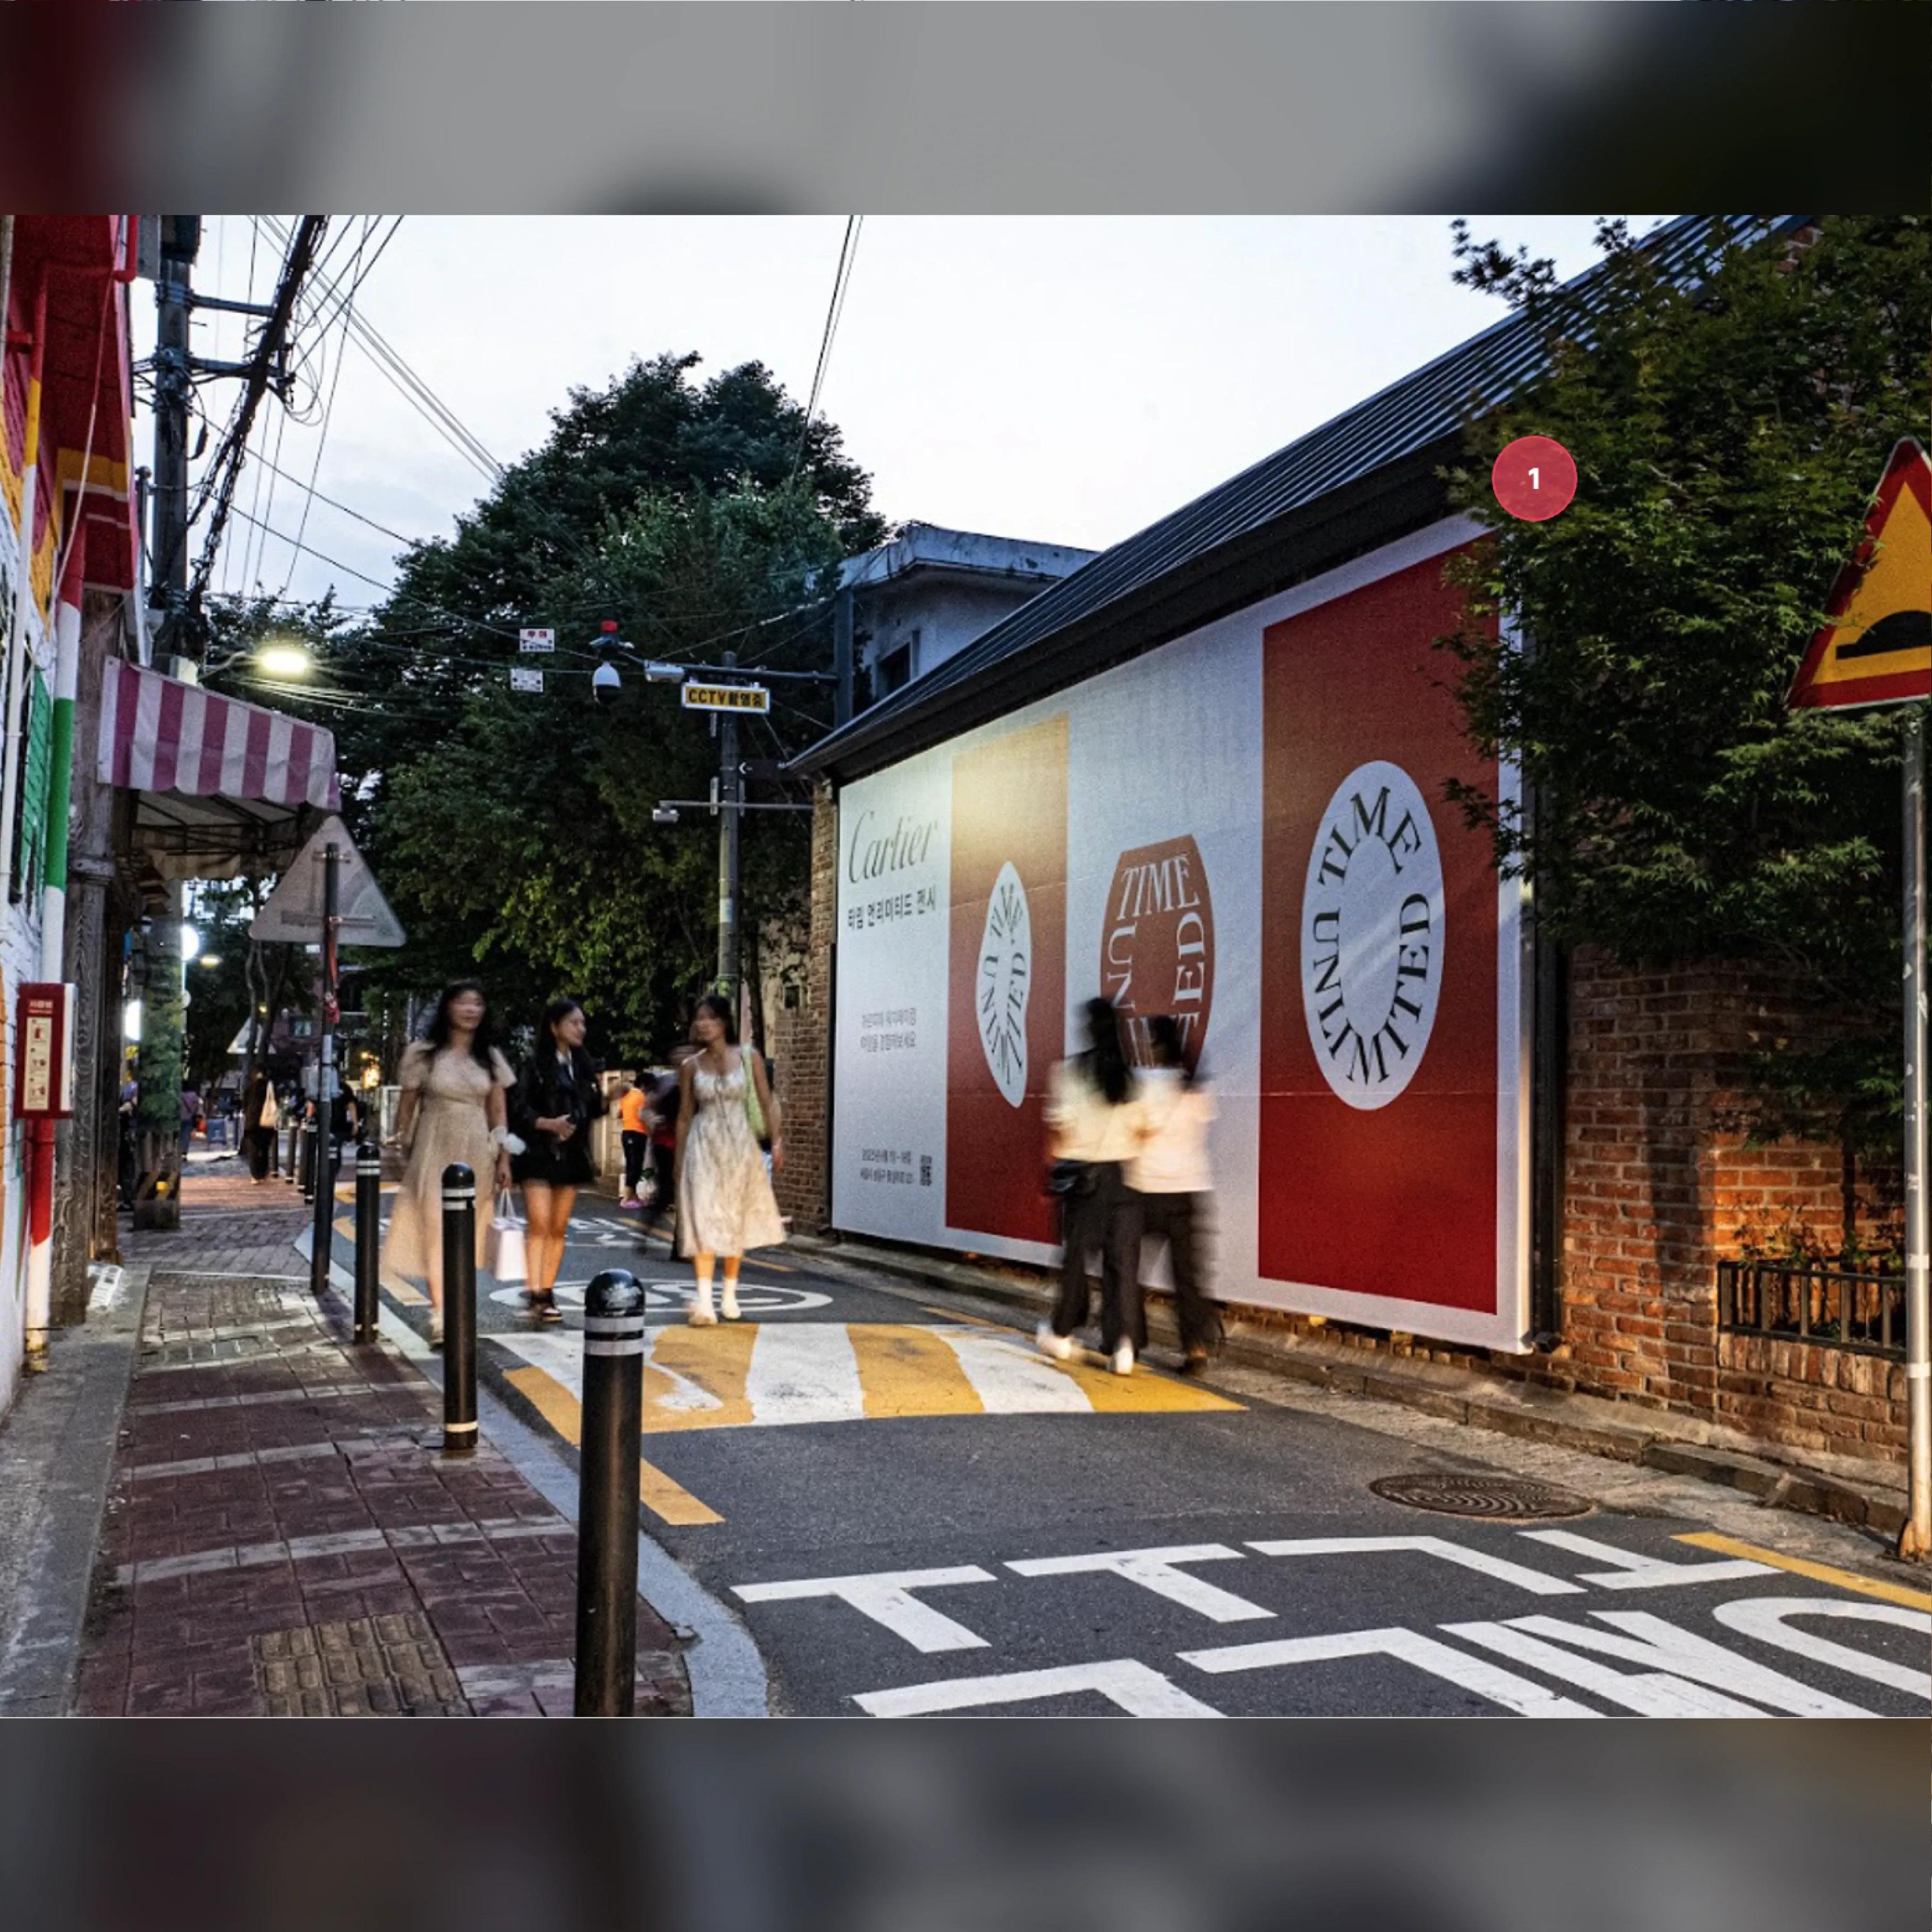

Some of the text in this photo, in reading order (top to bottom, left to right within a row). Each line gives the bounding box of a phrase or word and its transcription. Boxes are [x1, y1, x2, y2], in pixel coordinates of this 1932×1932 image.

[849, 810, 938, 884] Cartier
[848, 905, 865, 930] 타임
[868, 893, 913, 927] 언리미티드
[1116, 852, 1201, 921] TIME
[1312, 785, 1431, 1086] TIME UNLIMITED
